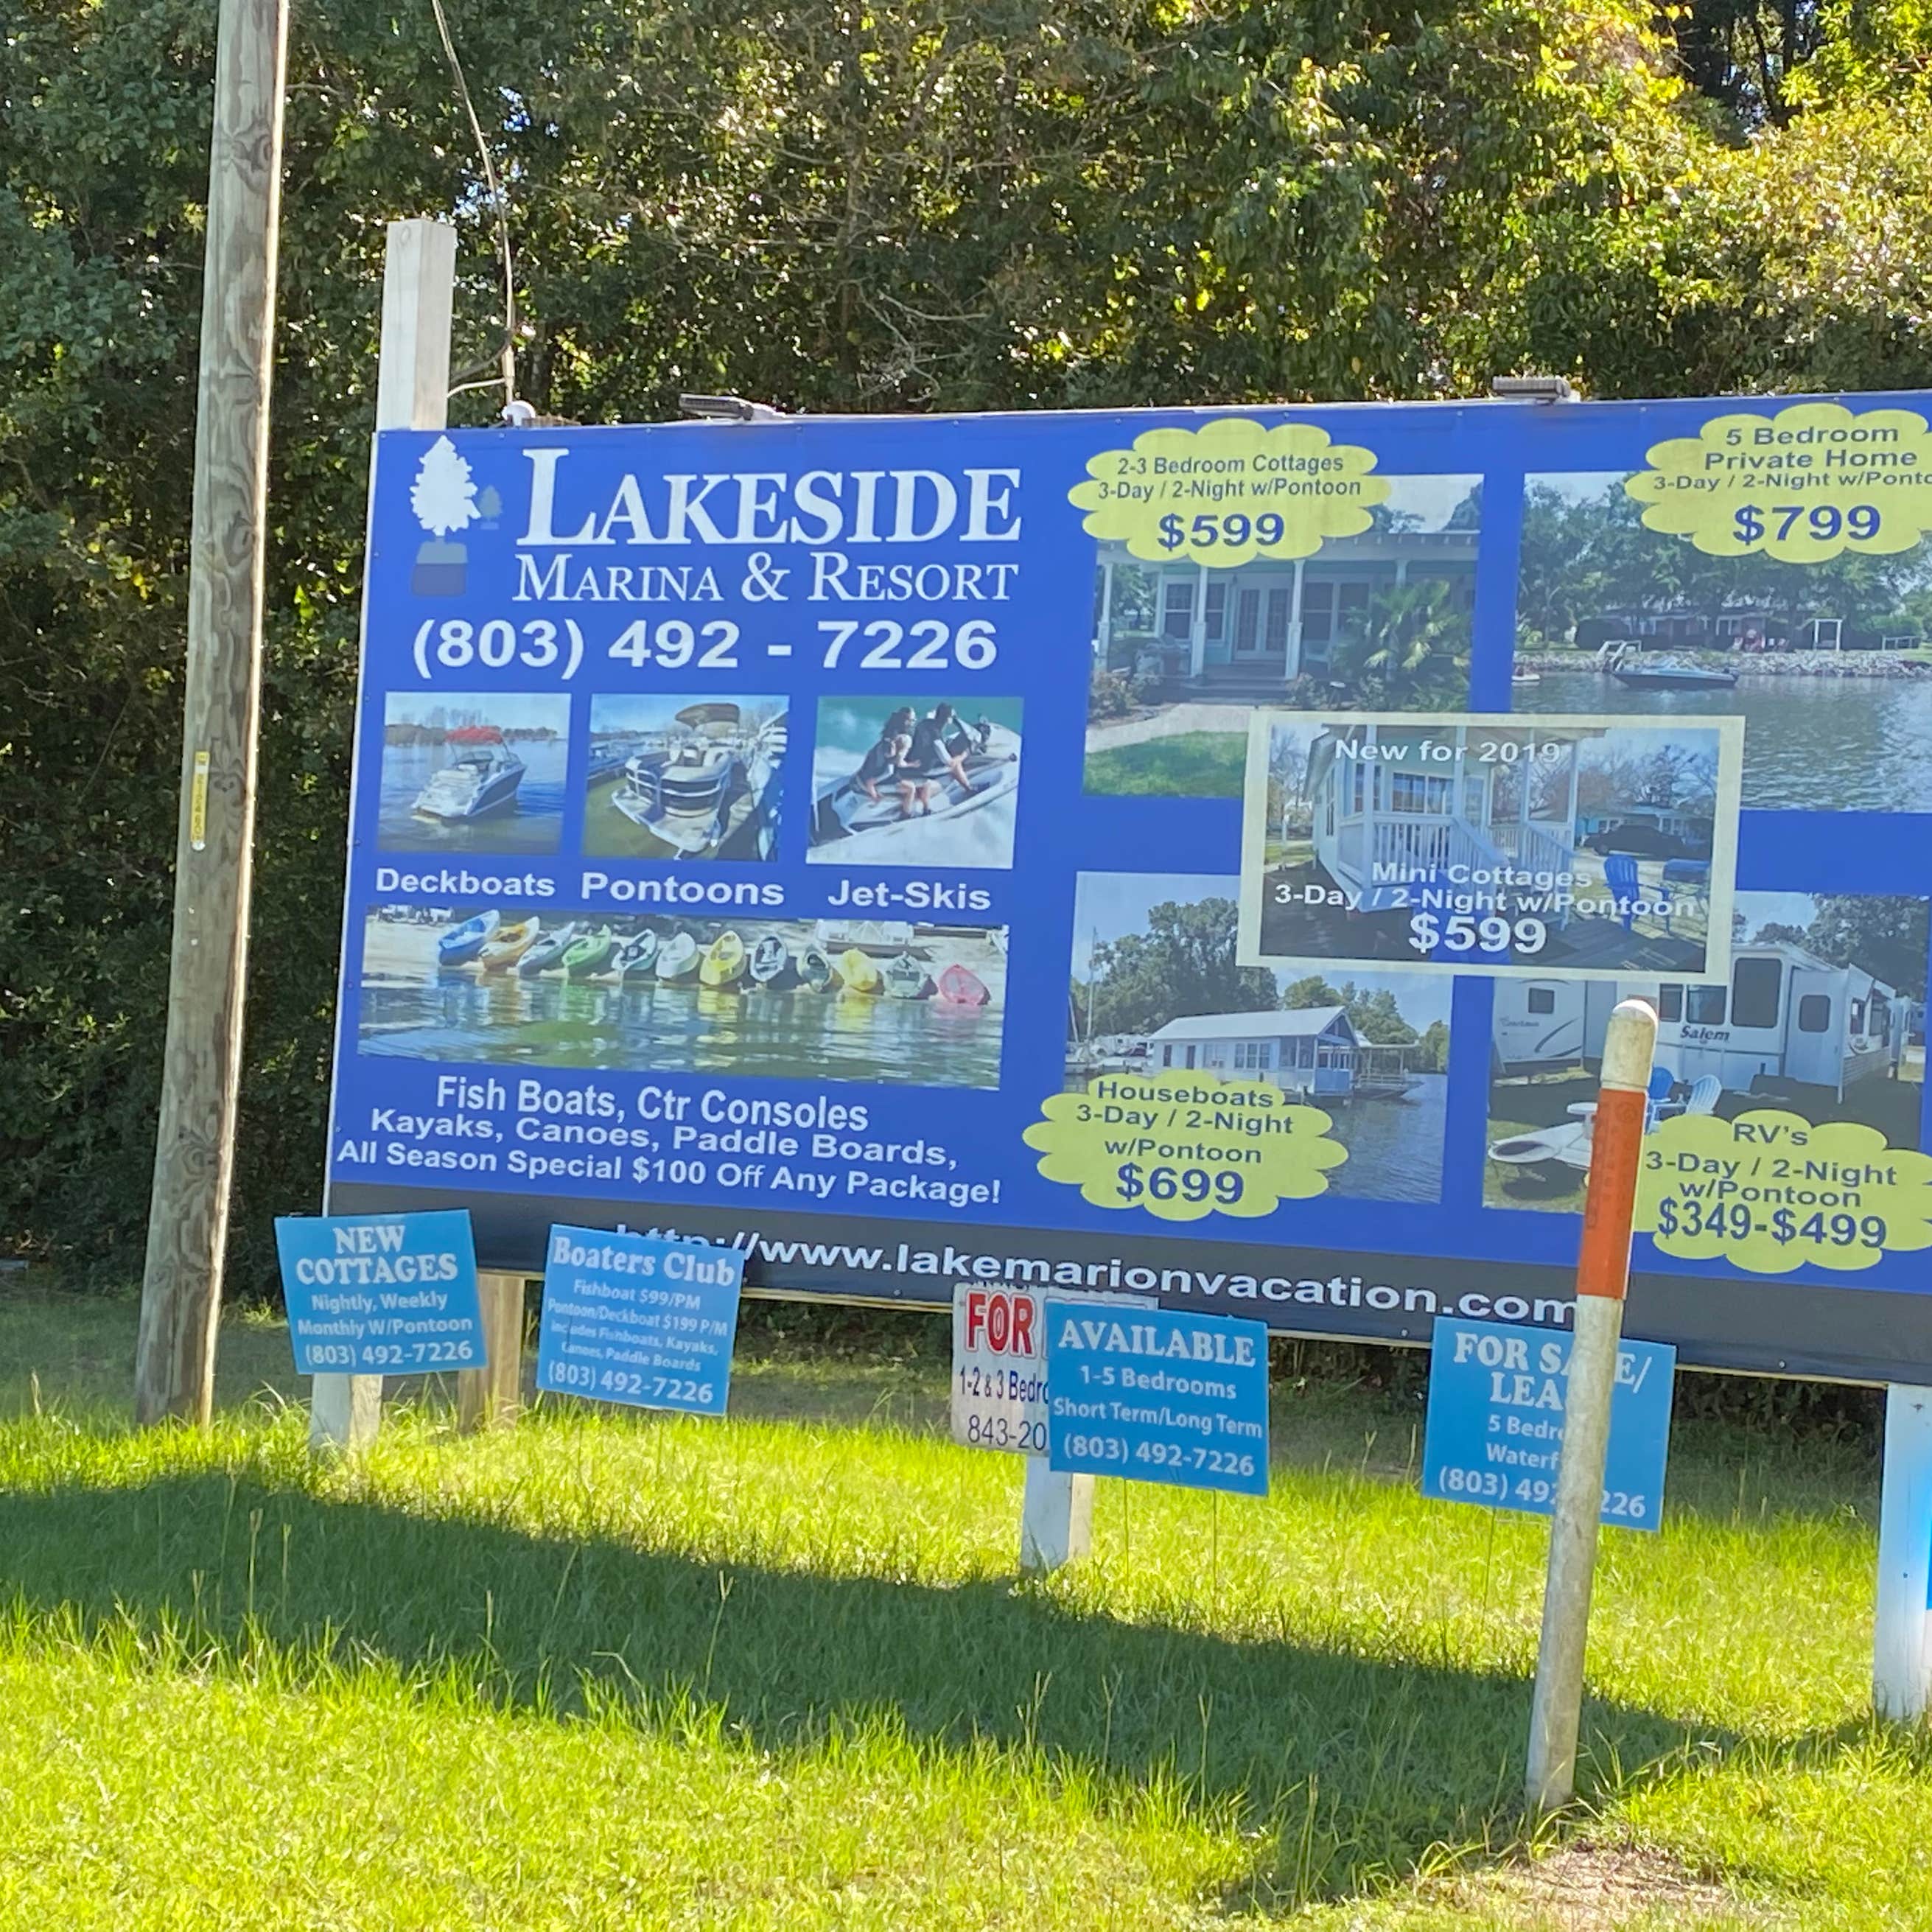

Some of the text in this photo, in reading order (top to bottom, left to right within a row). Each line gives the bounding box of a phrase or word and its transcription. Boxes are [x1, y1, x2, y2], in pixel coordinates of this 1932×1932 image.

[1726, 427, 1898, 446] 5 Bedroom
[1118, 455, 1343, 475] 2-3 Bedroom Cottages
[1705, 449, 1917, 470] Private Home
[517, 447, 1021, 546] LAKESIDE
[1099, 478, 1361, 502] 3-Day / 2-Night w/Pontoon
[1654, 471, 1932, 491] 3-Day / 2-Night w/Ponto
[1158, 513, 1285, 551] $599
[1733, 504, 1881, 545] $799
[512, 550, 1019, 603] MARINA & RESORT
[413, 619, 997, 680] (803) 492 - 7226
[1334, 739, 1561, 764] New for 2019
[376, 867, 556, 897] Deckboats
[581, 872, 784, 906] Pontoons
[1371, 863, 1592, 890] Mini Cottages
[827, 880, 992, 911] Jet-Skis
[1274, 884, 1695, 917] 3-Day / 2-Night w/Pontoon
[1410, 912, 1547, 955] $599
[1680, 1025, 1730, 1043] Salem
[436, 1076, 868, 1131] Fish Boats, Ctr Consoles
[1098, 1081, 1274, 1107] Houseboats
[1077, 1105, 1293, 1136] 3-Day / 2-Night
[1733, 1124, 1808, 1146] RV's
[370, 1109, 959, 1169] Kayaks, Canoes, Paddle Boards,
[1105, 1138, 1262, 1163] w/Pontoon
[337, 1141, 1001, 1207] All Season Special $100 Off Any Package!
[1116, 1162, 1244, 1205] $699
[1646, 1151, 1897, 1187] 3-Day / 2-Night
[1679, 1180, 1861, 1207] w/Pontoon
[333, 1225, 405, 1253] NEW
[1658, 1197, 1886, 1248] $349-$499
[296, 1253, 458, 1285] COTTAGES
[553, 1236, 735, 1287] Boaters Club
[312, 1290, 447, 1314] Nightly, Weekly
[574, 1279, 700, 1310] Fishboat $99/PM
[298, 1318, 472, 1340] Monthly W/Pontoon
[664, 1315, 696, 1334] $199
[701, 1320, 728, 1337] P/M
[967, 1291, 1035, 1357] FOR
[305, 1340, 473, 1368] (803) 492-7226
[606, 1348, 649, 1365] Paddle
[654, 1354, 701, 1372] Boards
[1058, 1319, 1256, 1368] AVAILABLE
[1454, 1332, 1652, 1393] FOR SE/
[548, 1360, 713, 1404] (803) 492-7226
[959, 1365, 980, 1396] 1-2
[984, 1373, 992, 1398] &
[997, 1369, 1004, 1399] 3
[1080, 1365, 1237, 1400] 1-5 Bedrooms
[1490, 1372, 1564, 1411] LEA
[967, 1414, 1046, 1450] 843-20
[1054, 1397, 1262, 1438] Short Term/Long Term
[1488, 1415, 1500, 1432] 5
[1064, 1434, 1255, 1477] (803) 492-7226
[1486, 1443, 1561, 1471] Waterf
[1439, 1466, 1508, 1501] (803)
